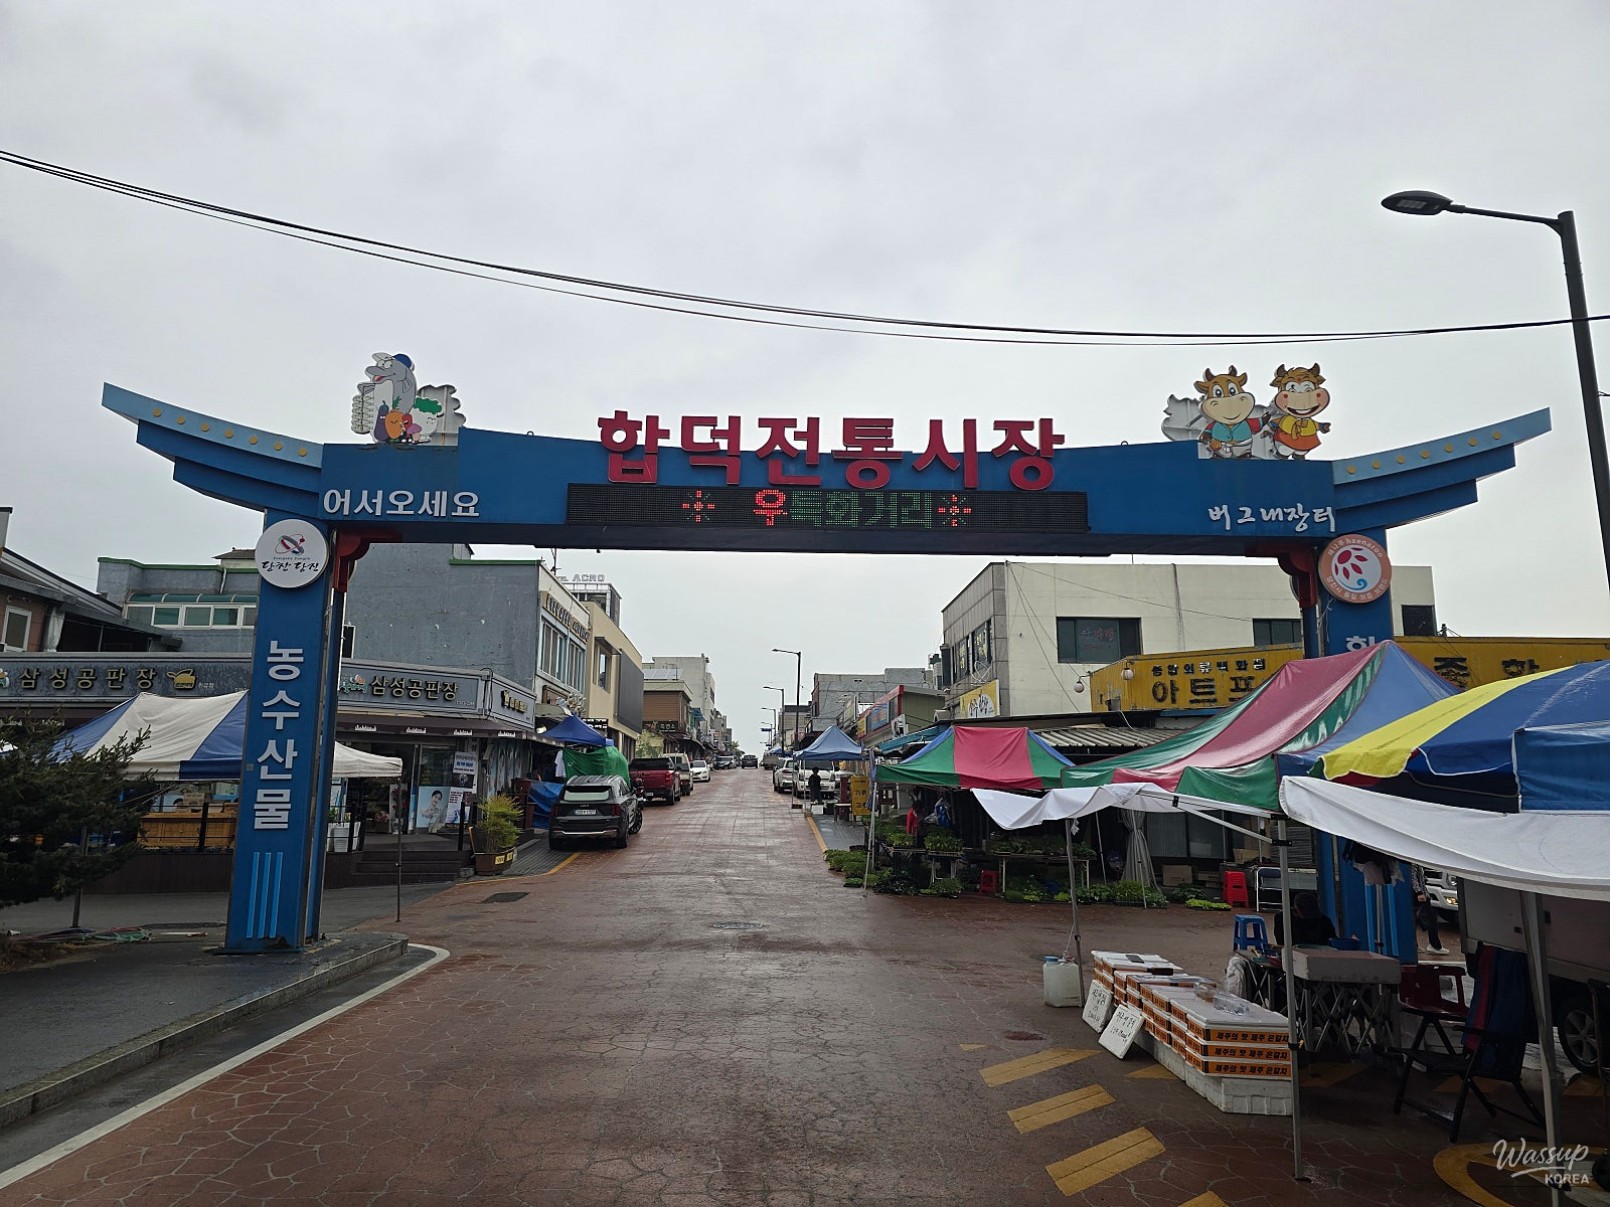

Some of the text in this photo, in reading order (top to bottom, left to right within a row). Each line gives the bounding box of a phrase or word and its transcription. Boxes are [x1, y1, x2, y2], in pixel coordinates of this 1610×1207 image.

[599, 410, 1066, 490] 합덕전통시장
[323, 489, 480, 518] 어서오세요
[18, 668, 156, 690] 삼성공판장
[371, 676, 459, 701] 삼성공판장
[254, 640, 304, 830] 농수산물
